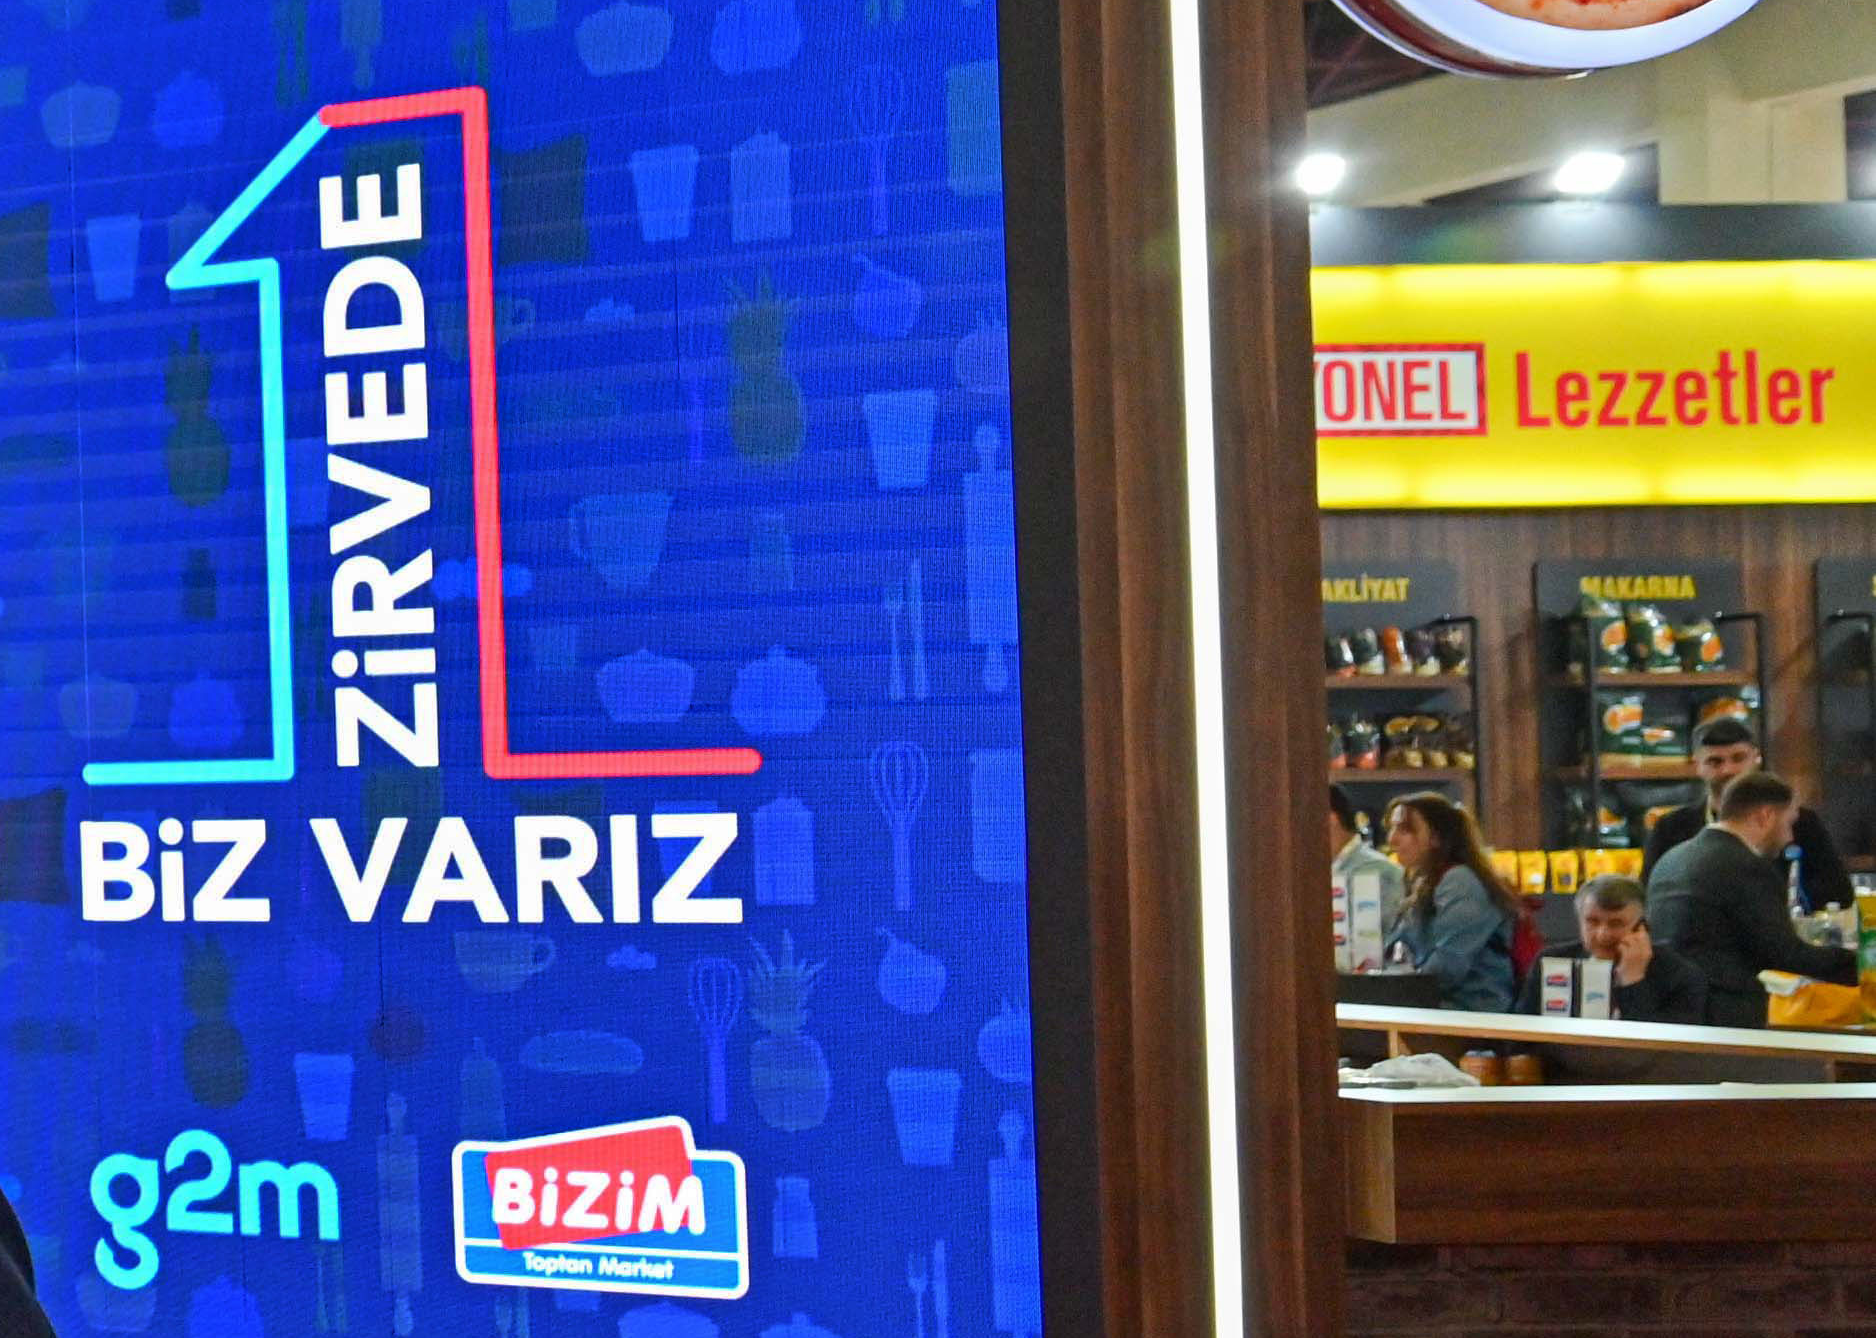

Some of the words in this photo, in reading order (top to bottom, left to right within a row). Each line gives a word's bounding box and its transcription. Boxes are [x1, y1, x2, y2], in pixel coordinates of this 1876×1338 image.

[1314, 360, 1467, 422] ONEL
[1516, 349, 1835, 428] Lezzetler
[309, 812, 743, 924] VARIZ
[90, 1129, 340, 1290] g2m
[523, 1251, 593, 1277] Toptan
[598, 1256, 674, 1280] Market
